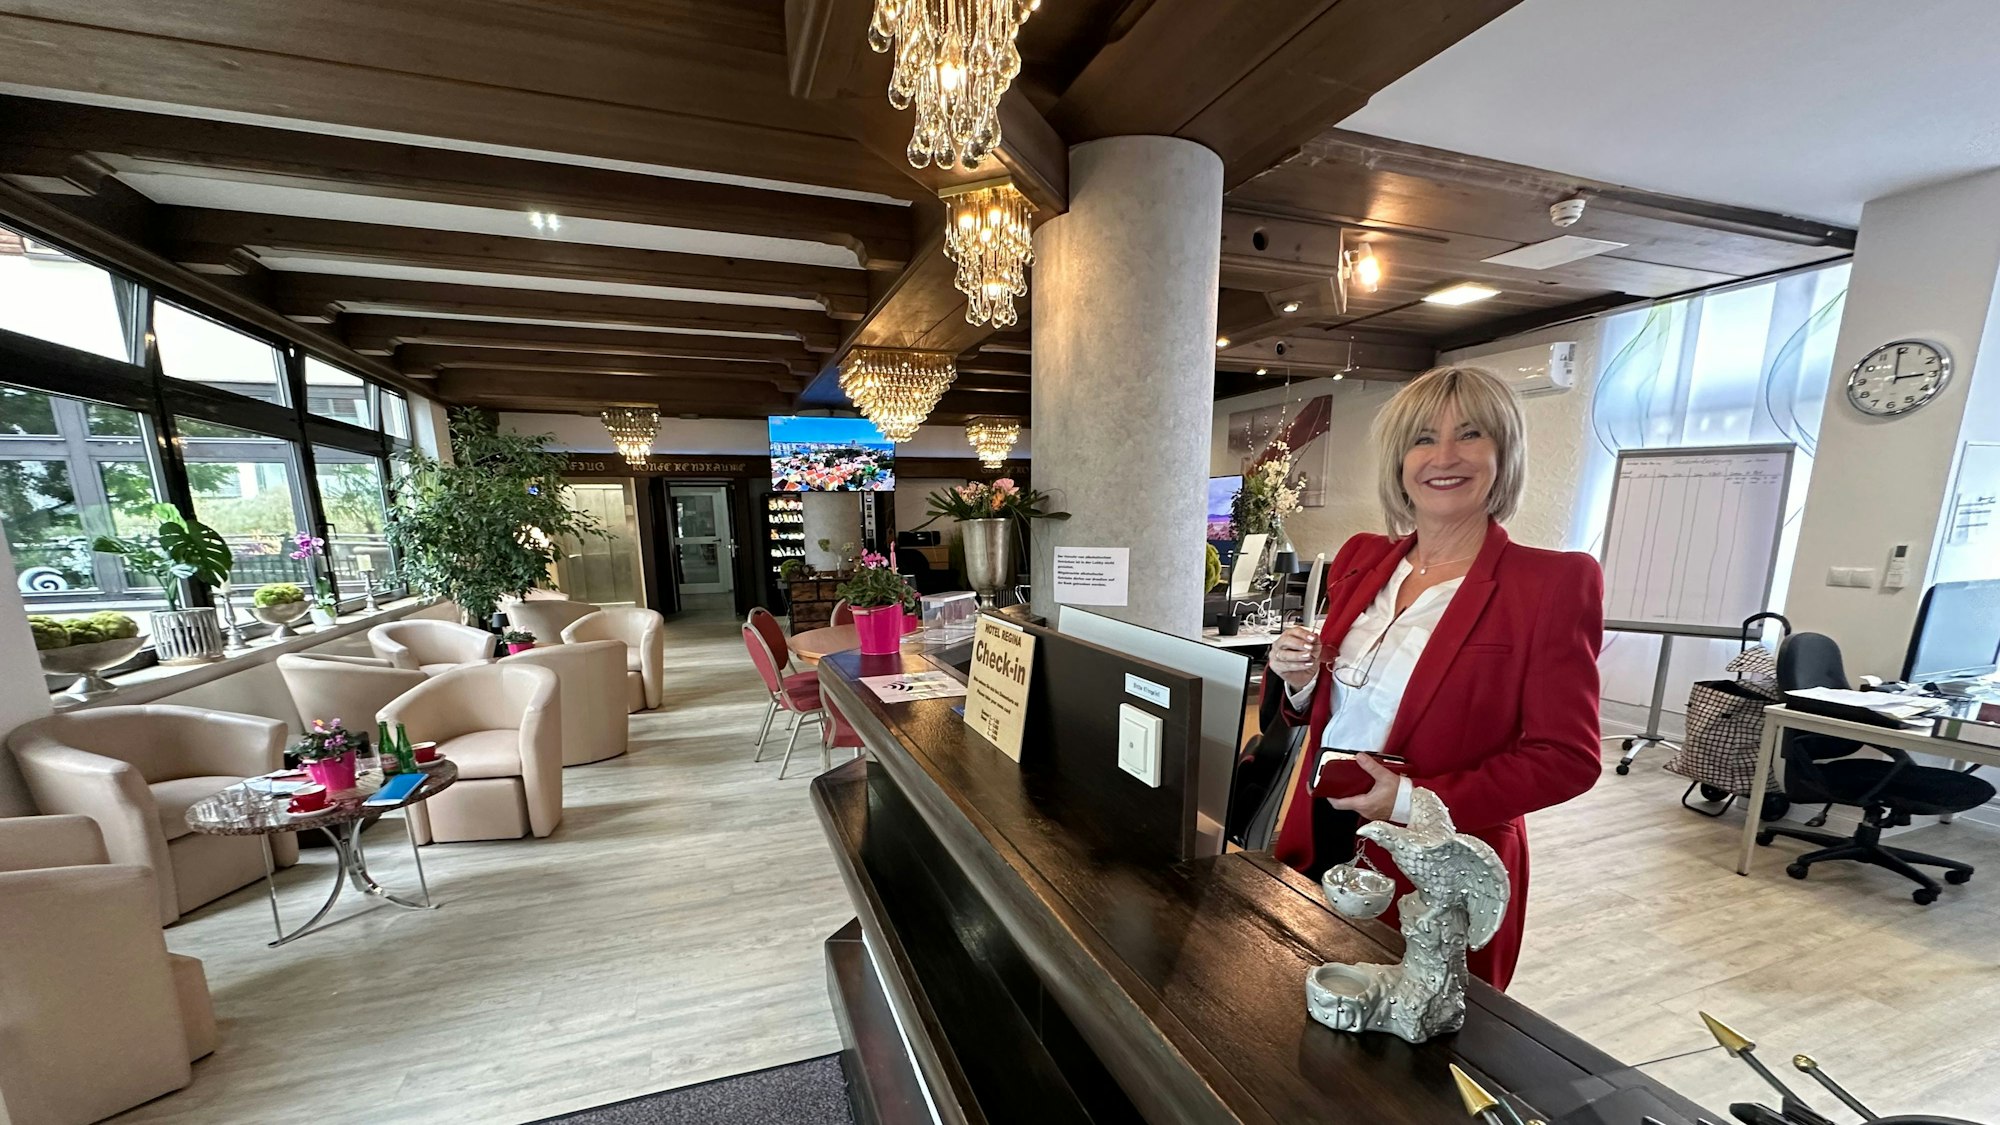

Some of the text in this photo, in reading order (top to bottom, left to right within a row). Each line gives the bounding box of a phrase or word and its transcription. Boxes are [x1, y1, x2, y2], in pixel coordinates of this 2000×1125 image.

[1925, 356, 1936, 365] 2
[1928, 370, 1939, 378] 3
[1856, 378, 1867, 386] 9
[1860, 391, 1870, 399] 8
[1870, 399, 1880, 407] 7
[1904, 395, 1915, 404] 5
[1886, 401, 1896, 409] 6
[985, 623, 1022, 648] HOTEL REGINA
[976, 640, 1026, 686] Check-in
